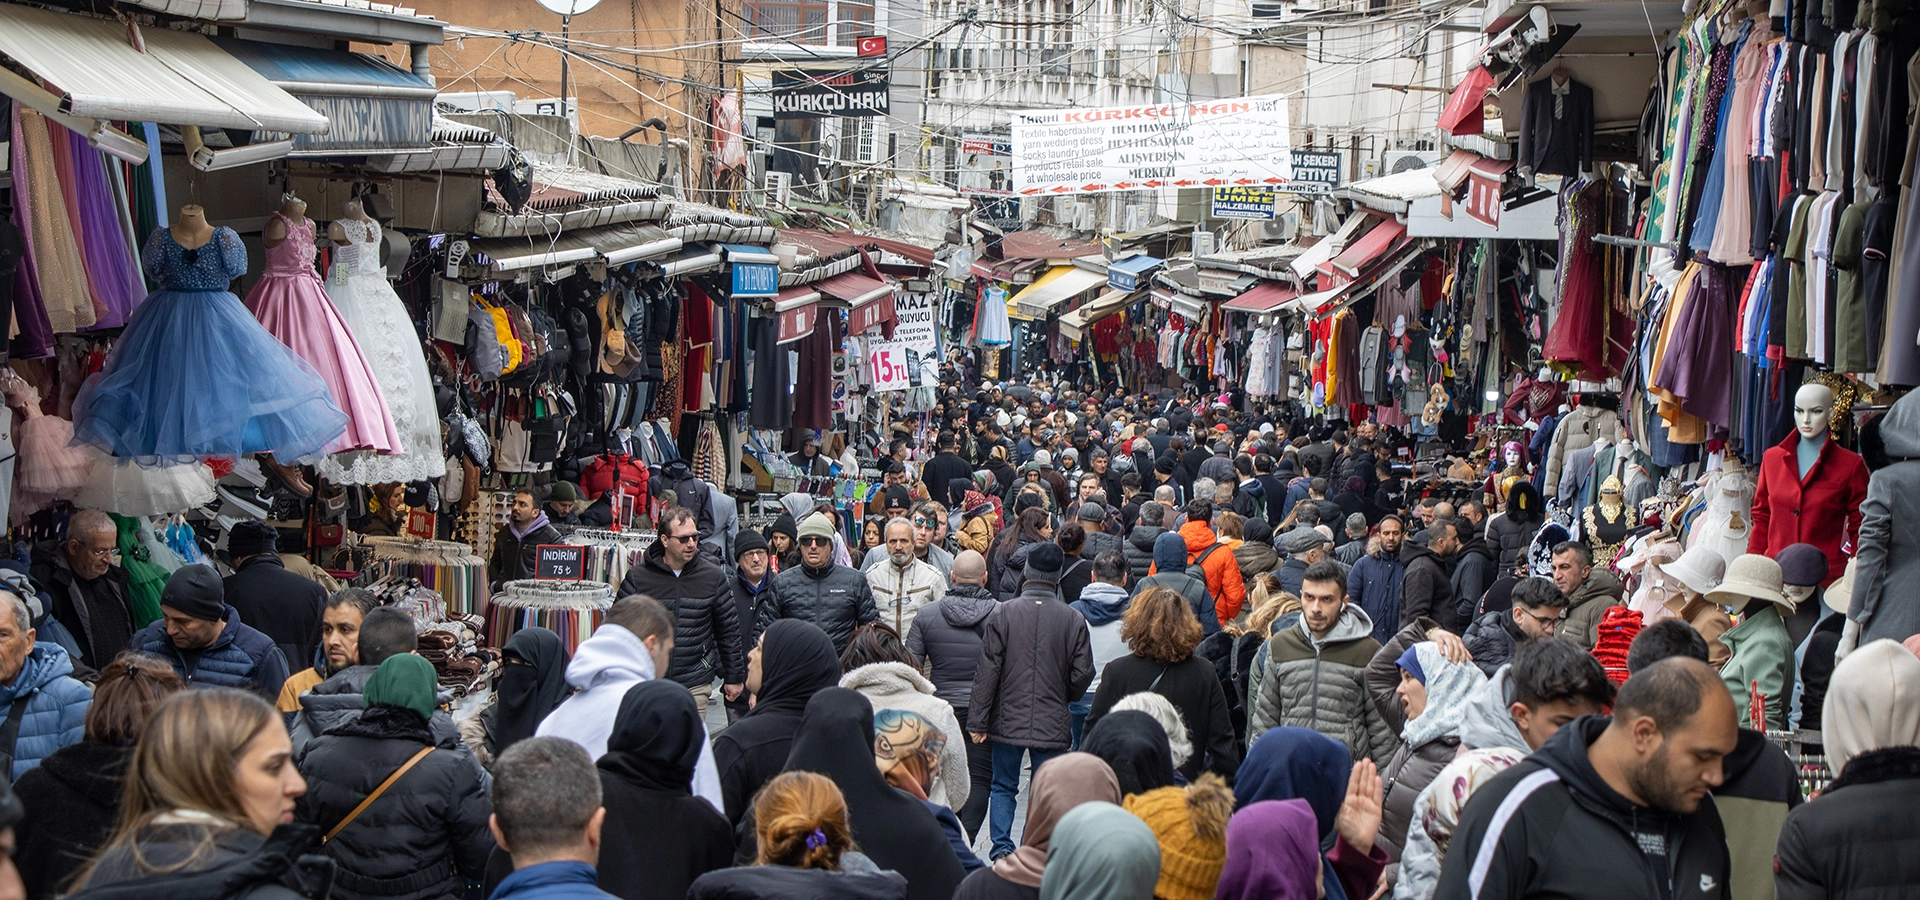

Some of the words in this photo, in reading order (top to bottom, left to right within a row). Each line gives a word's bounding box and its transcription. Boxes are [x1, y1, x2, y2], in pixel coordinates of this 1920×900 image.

[775, 90, 845, 114] KÜRKÇÜ
[849, 91, 887, 109] HAN
[1020, 113, 1059, 124] TARİHİ
[1065, 103, 1178, 123] KÜRKÇÜ
[1190, 102, 1249, 116] HAN
[1020, 128, 1047, 138] Textile
[1048, 126, 1105, 137] haberdashery
[1112, 124, 1137, 134] HEM
[1022, 141, 1041, 152] yarn
[1043, 137, 1078, 149] wedding
[1081, 136, 1103, 145] dress
[1108, 138, 1134, 149] HEM
[1023, 150, 1046, 160] socks
[1048, 148, 1079, 160] laundry
[1081, 146, 1104, 156] towel
[1024, 161, 1061, 174] products
[1062, 159, 1084, 169] retail
[1086, 157, 1103, 168] sale
[1303, 154, 1338, 167] ŞEKERİ
[1027, 174, 1035, 183] at
[1036, 171, 1078, 182] wholesale
[1080, 170, 1102, 182] price
[1128, 165, 1176, 179] MERKEZİ
[1292, 167, 1337, 182] VETİYE
[1215, 194, 1274, 204] UMRE
[1214, 202, 1274, 212] MALZEMELERİ
[896, 292, 928, 311] MAZ
[896, 311, 931, 324] RUYUCU
[899, 327, 932, 336] TELEFONA
[904, 335, 929, 343] YAPILIR
[543, 549, 577, 561] İNDİRİM
[553, 565, 564, 575] 75
